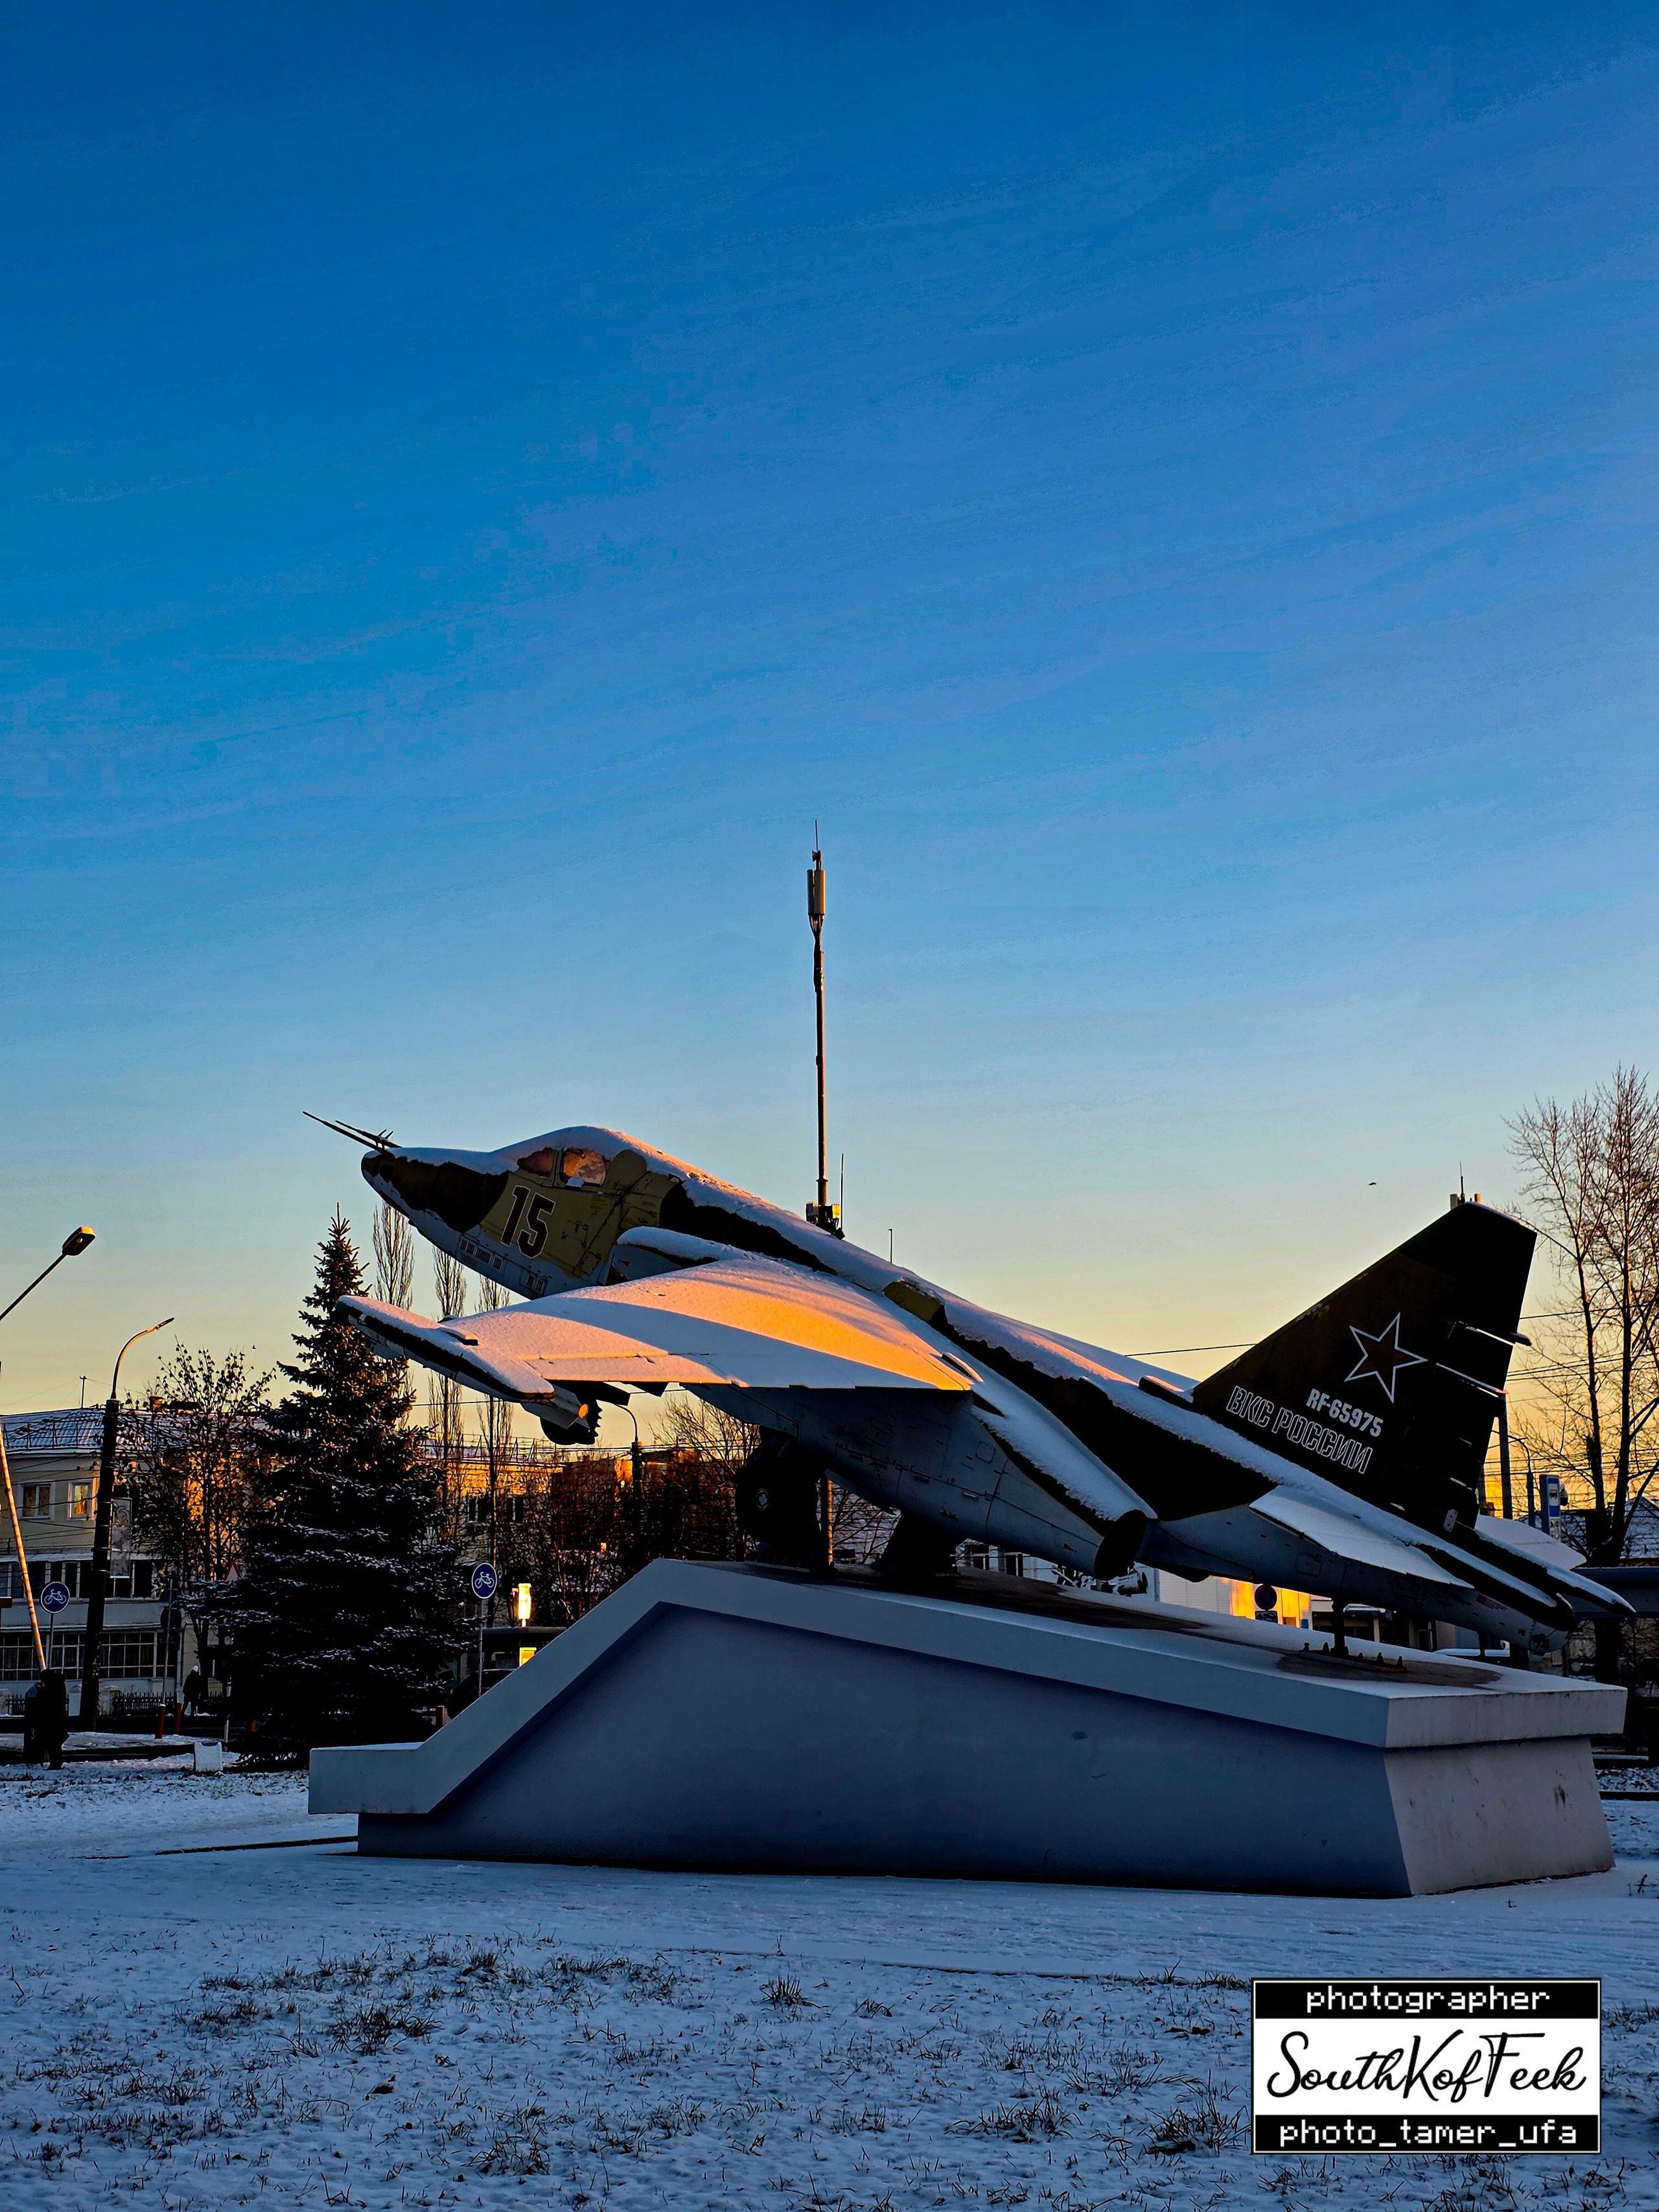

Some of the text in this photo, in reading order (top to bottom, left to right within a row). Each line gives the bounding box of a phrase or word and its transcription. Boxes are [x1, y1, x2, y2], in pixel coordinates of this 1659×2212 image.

[500, 1185, 556, 1259] 15
[1226, 1385, 1373, 1474] ВКС РОССИИ
[1306, 1388, 1384, 1437] RF-65975
